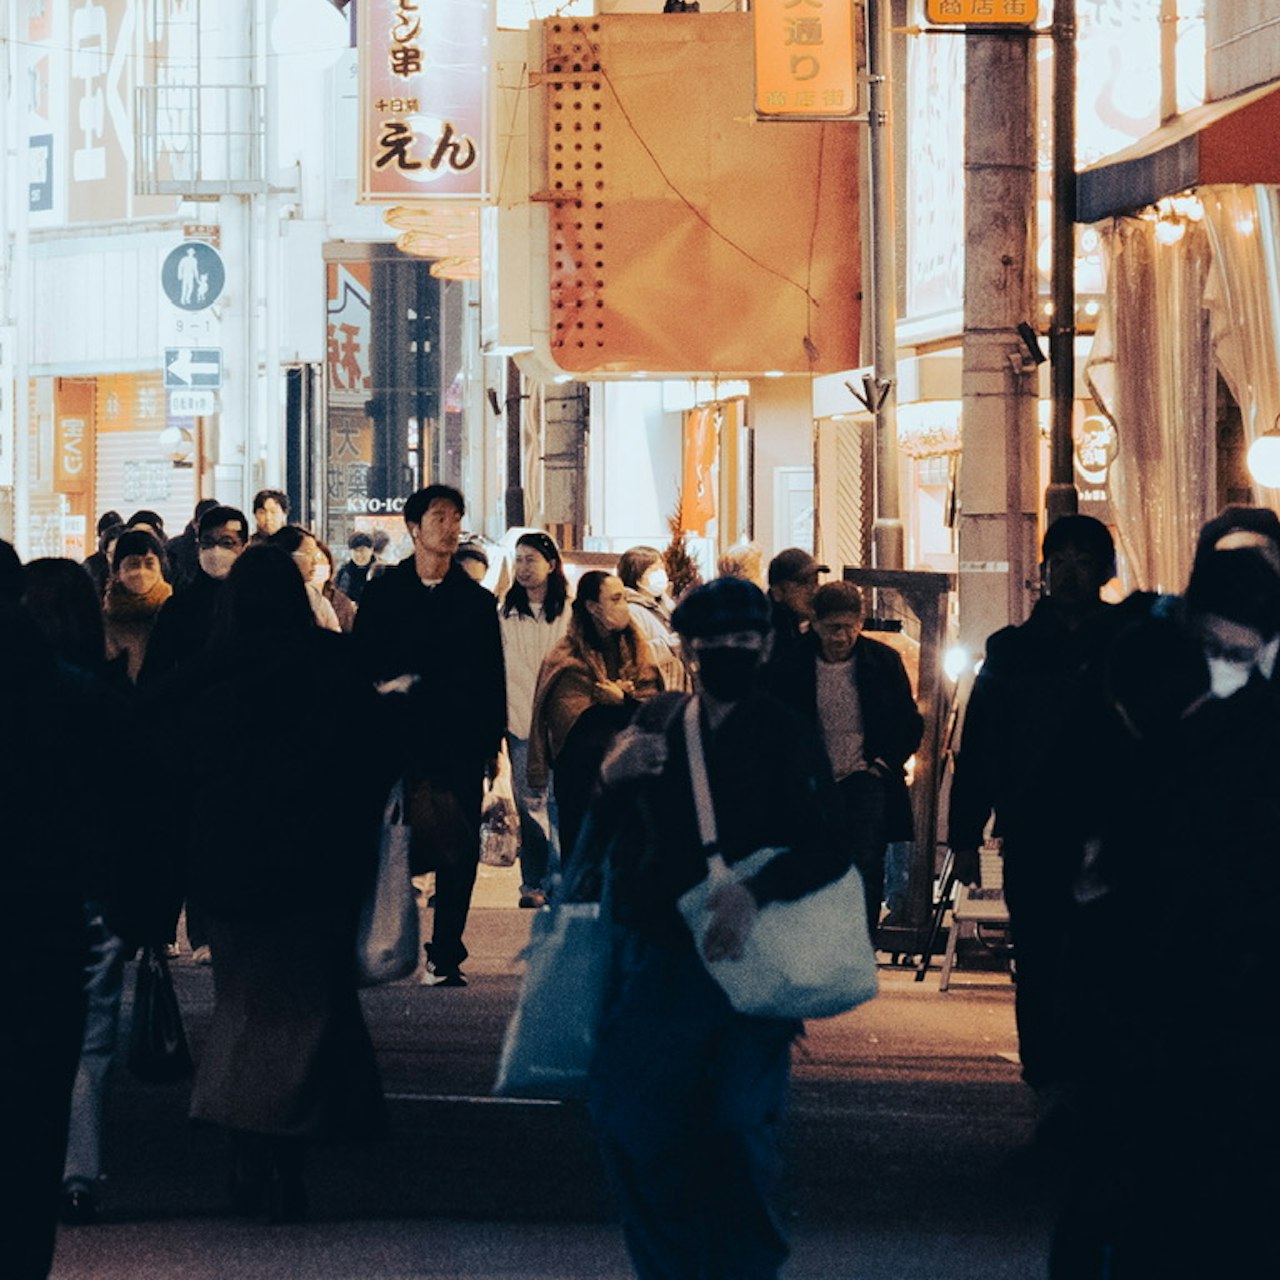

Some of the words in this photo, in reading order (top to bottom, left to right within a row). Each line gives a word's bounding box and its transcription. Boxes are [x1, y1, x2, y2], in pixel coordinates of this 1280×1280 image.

[766, 90, 845, 107] 商店街
[375, 122, 476, 171] えん
